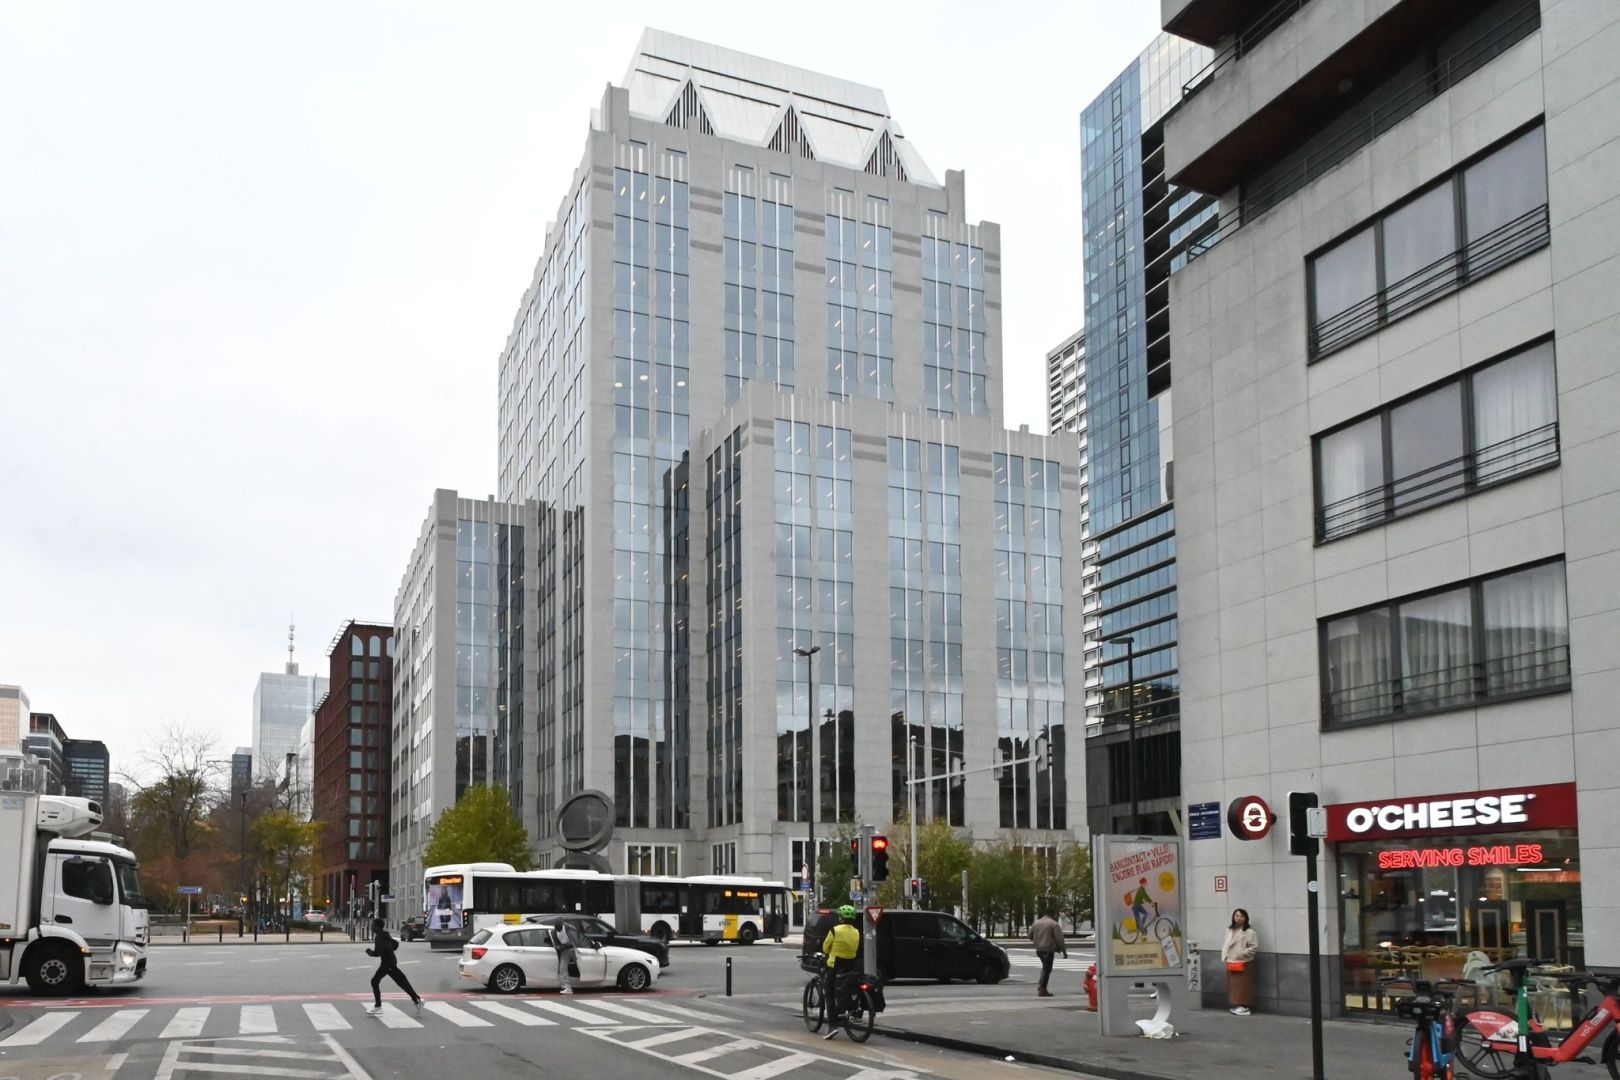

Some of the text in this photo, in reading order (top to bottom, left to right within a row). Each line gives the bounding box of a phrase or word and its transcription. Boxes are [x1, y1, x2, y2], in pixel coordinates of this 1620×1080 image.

[1378, 844, 1543, 869] SERVING SMILES
[1111, 866, 1136, 883] ENCORE
[1135, 861, 1151, 875] PLUS
